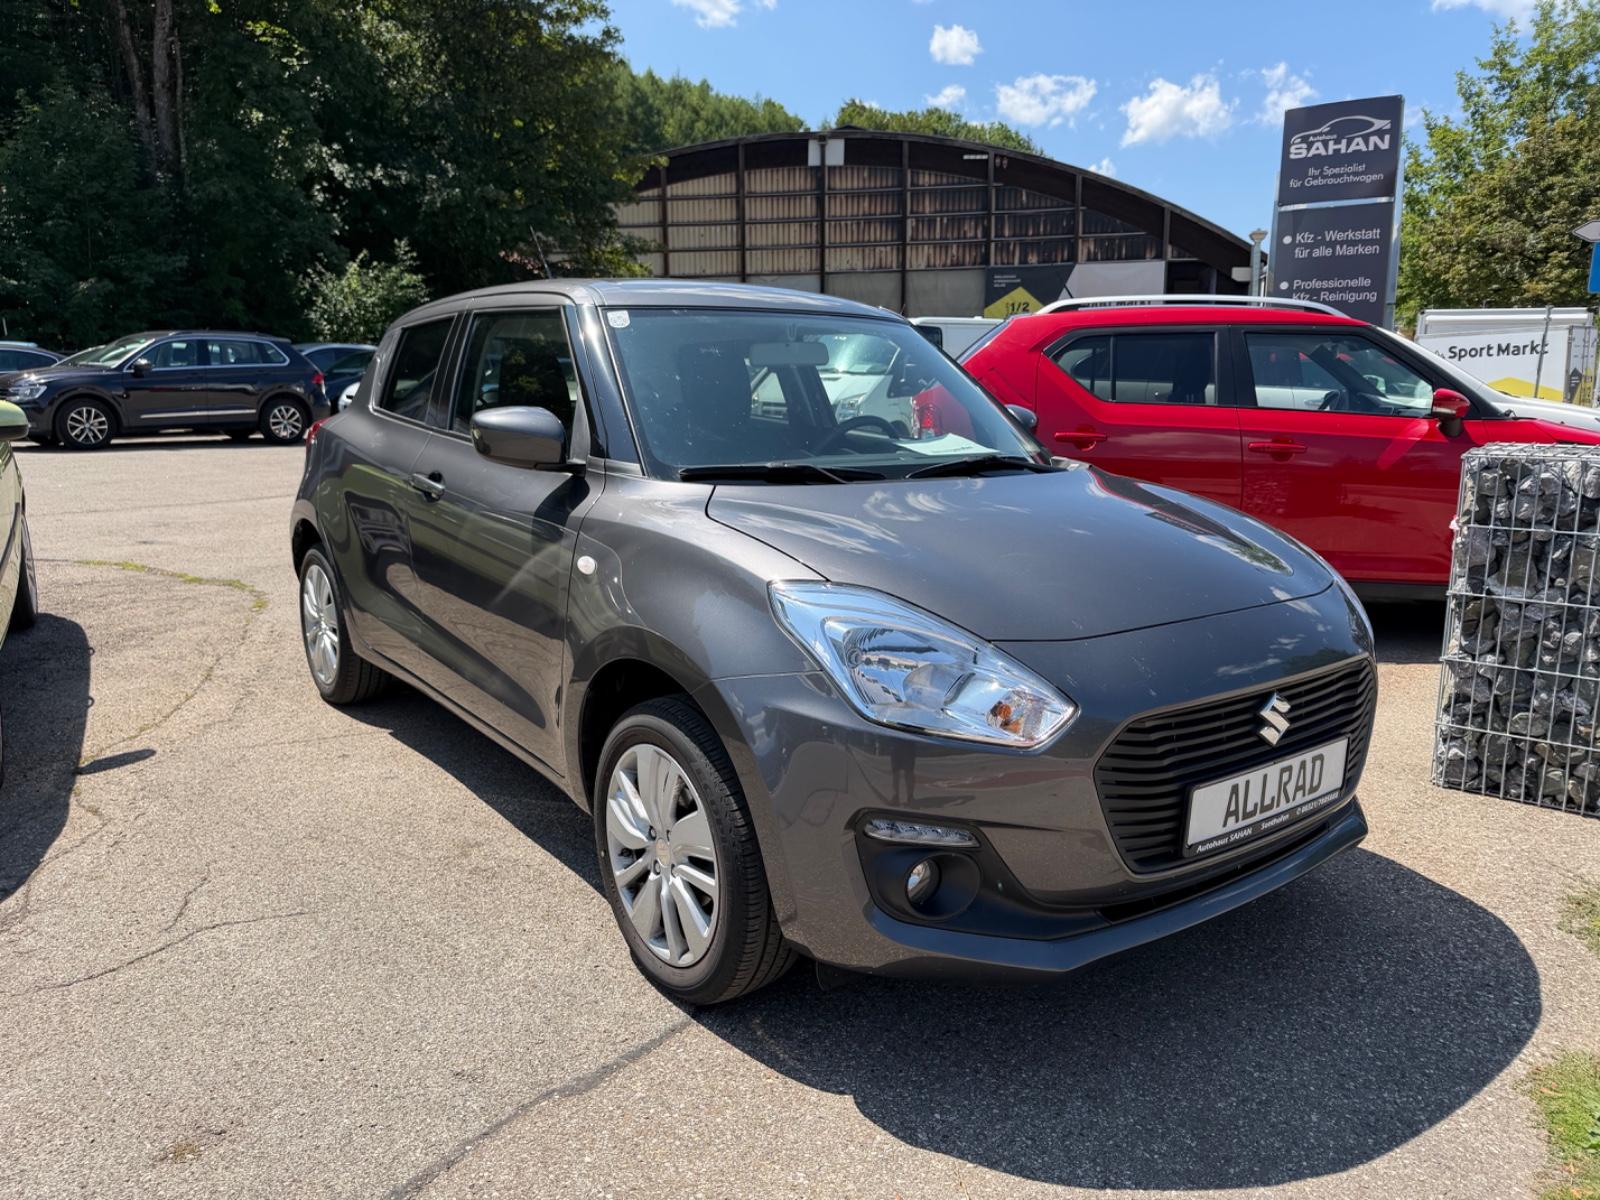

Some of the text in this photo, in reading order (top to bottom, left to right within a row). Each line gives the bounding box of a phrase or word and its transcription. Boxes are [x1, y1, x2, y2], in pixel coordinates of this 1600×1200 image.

[1289, 134, 1391, 159] SAHAN
[1308, 163, 1366, 177] Ihr Spezialist
[1289, 173, 1384, 188] für Gebrauchtwagen
[1295, 232, 1315, 243] Kfz
[1324, 228, 1381, 241] Werkstatt
[1294, 244, 1380, 258] für alle Marken
[1293, 276, 1371, 290] Professionelle
[1292, 291, 1310, 301] Kfz
[1320, 290, 1378, 303] Reinigung
[1447, 343, 1494, 361] Sport
[1222, 753, 1325, 828] ALLRAD
[1229, 827, 1253, 842] SAHAN
